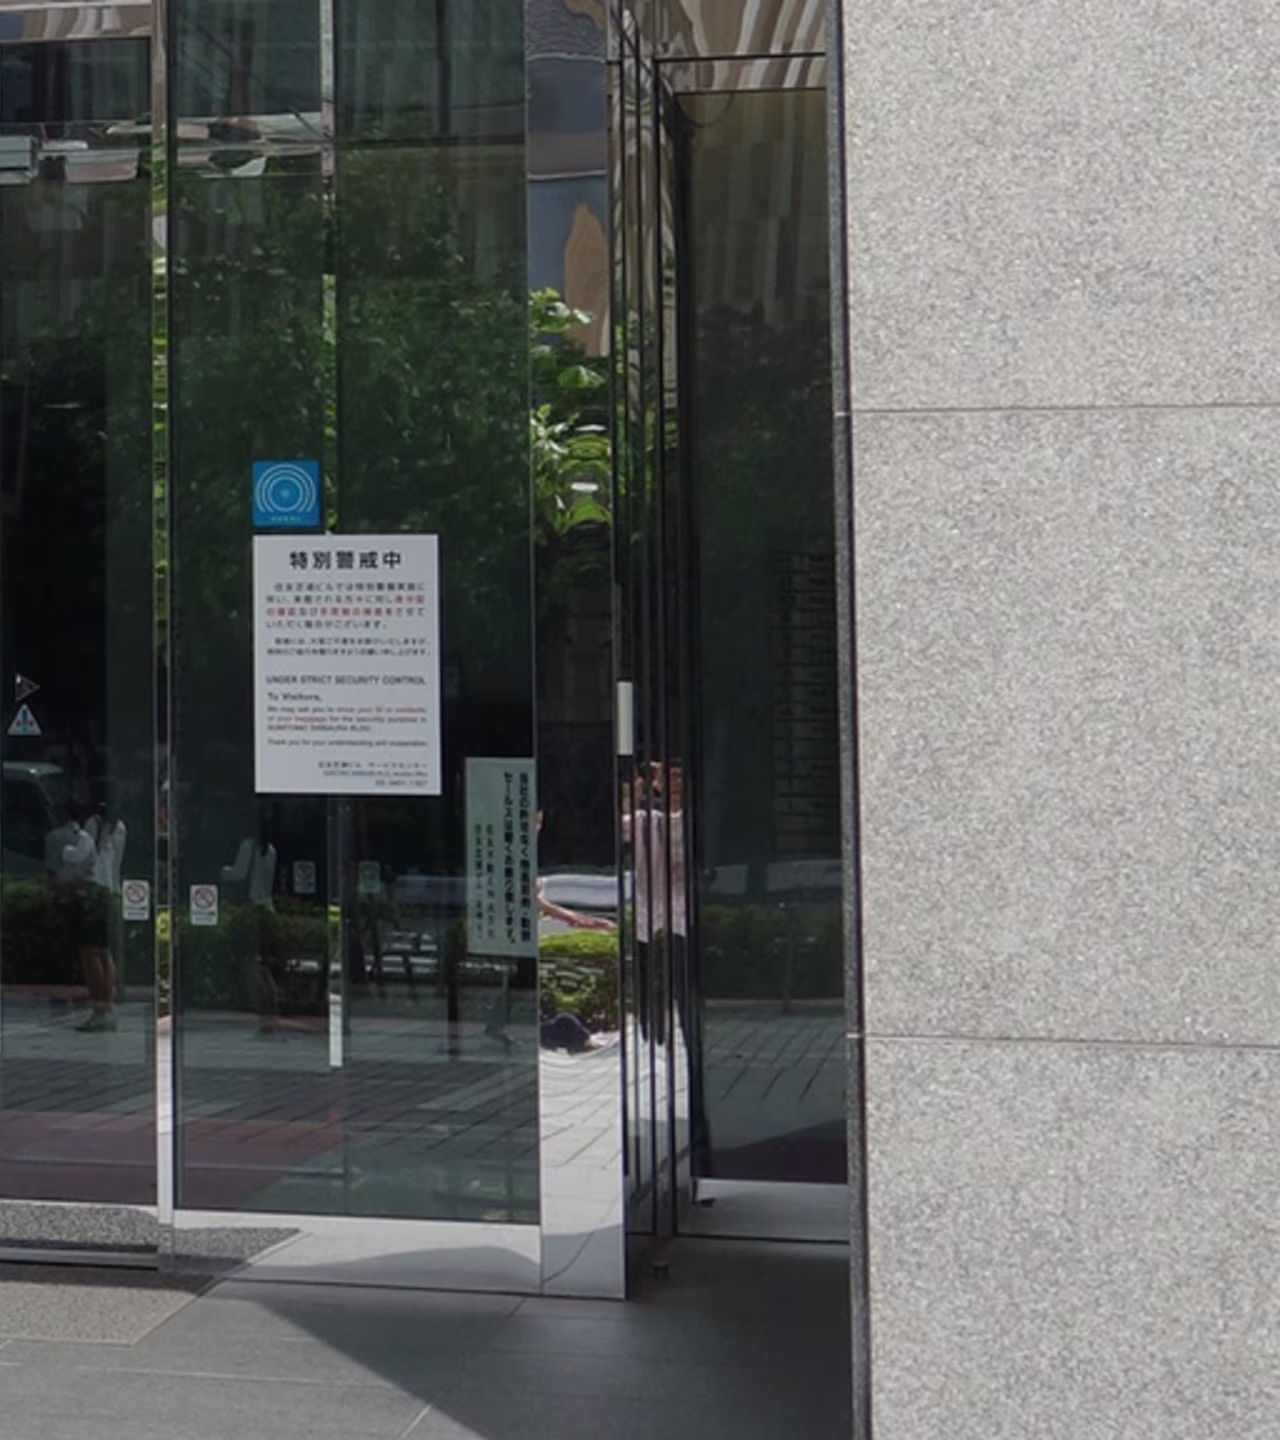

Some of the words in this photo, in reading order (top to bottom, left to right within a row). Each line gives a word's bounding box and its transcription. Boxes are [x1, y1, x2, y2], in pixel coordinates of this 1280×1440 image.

[290, 551, 401, 570] 特別警戒中
[266, 675, 297, 685] UNDER
[300, 675, 333, 685] STRICT
[335, 675, 380, 685] SECURITY
[382, 676, 427, 685] CONTROL
[267, 692, 279, 701] To
[282, 692, 323, 702] Visitors,
